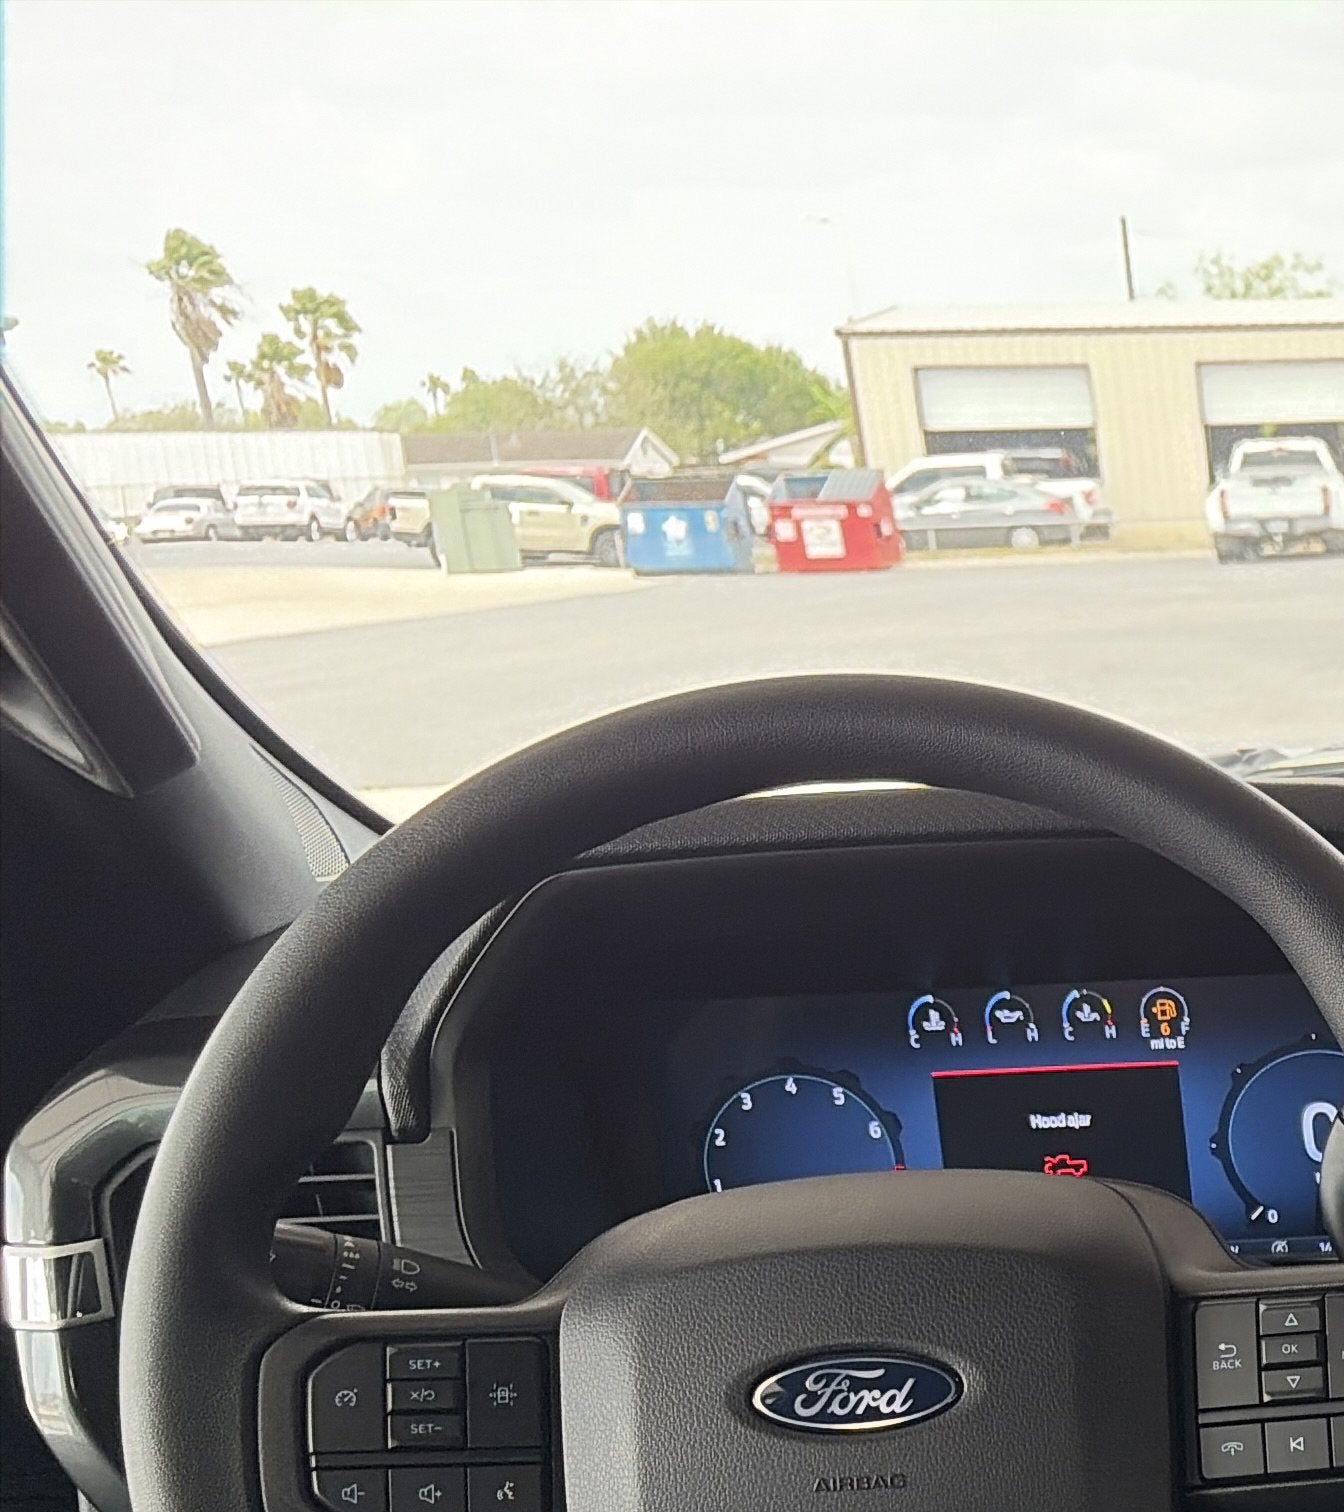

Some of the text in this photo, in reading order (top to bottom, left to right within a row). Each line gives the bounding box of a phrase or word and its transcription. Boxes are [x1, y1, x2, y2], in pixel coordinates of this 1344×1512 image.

[1026, 1028, 1039, 1042] H
[1064, 1026, 1075, 1041] C
[1104, 1025, 1117, 1039] H
[1141, 1024, 1150, 1038] E
[1160, 1023, 1171, 1036] 6
[1181, 1022, 1190, 1036] F
[909, 1032, 921, 1049] C
[950, 1032, 963, 1047] H
[986, 1031, 998, 1045] L
[1177, 1036, 1186, 1048] E
[784, 1077, 798, 1095] 4
[740, 1092, 752, 1111] 3
[832, 1086, 846, 1106] 5
[1029, 1112, 1092, 1129] Hood ajar
[868, 1120, 882, 1139] 6
[713, 1128, 727, 1147] 2
[713, 1178, 723, 1193] 1
[1266, 1208, 1279, 1224] 0
[1281, 1343, 1299, 1355] OK
[1212, 1359, 1242, 1371] BACK
[794, 1367, 916, 1417] Ford
[813, 1473, 907, 1492] AIRBAG
